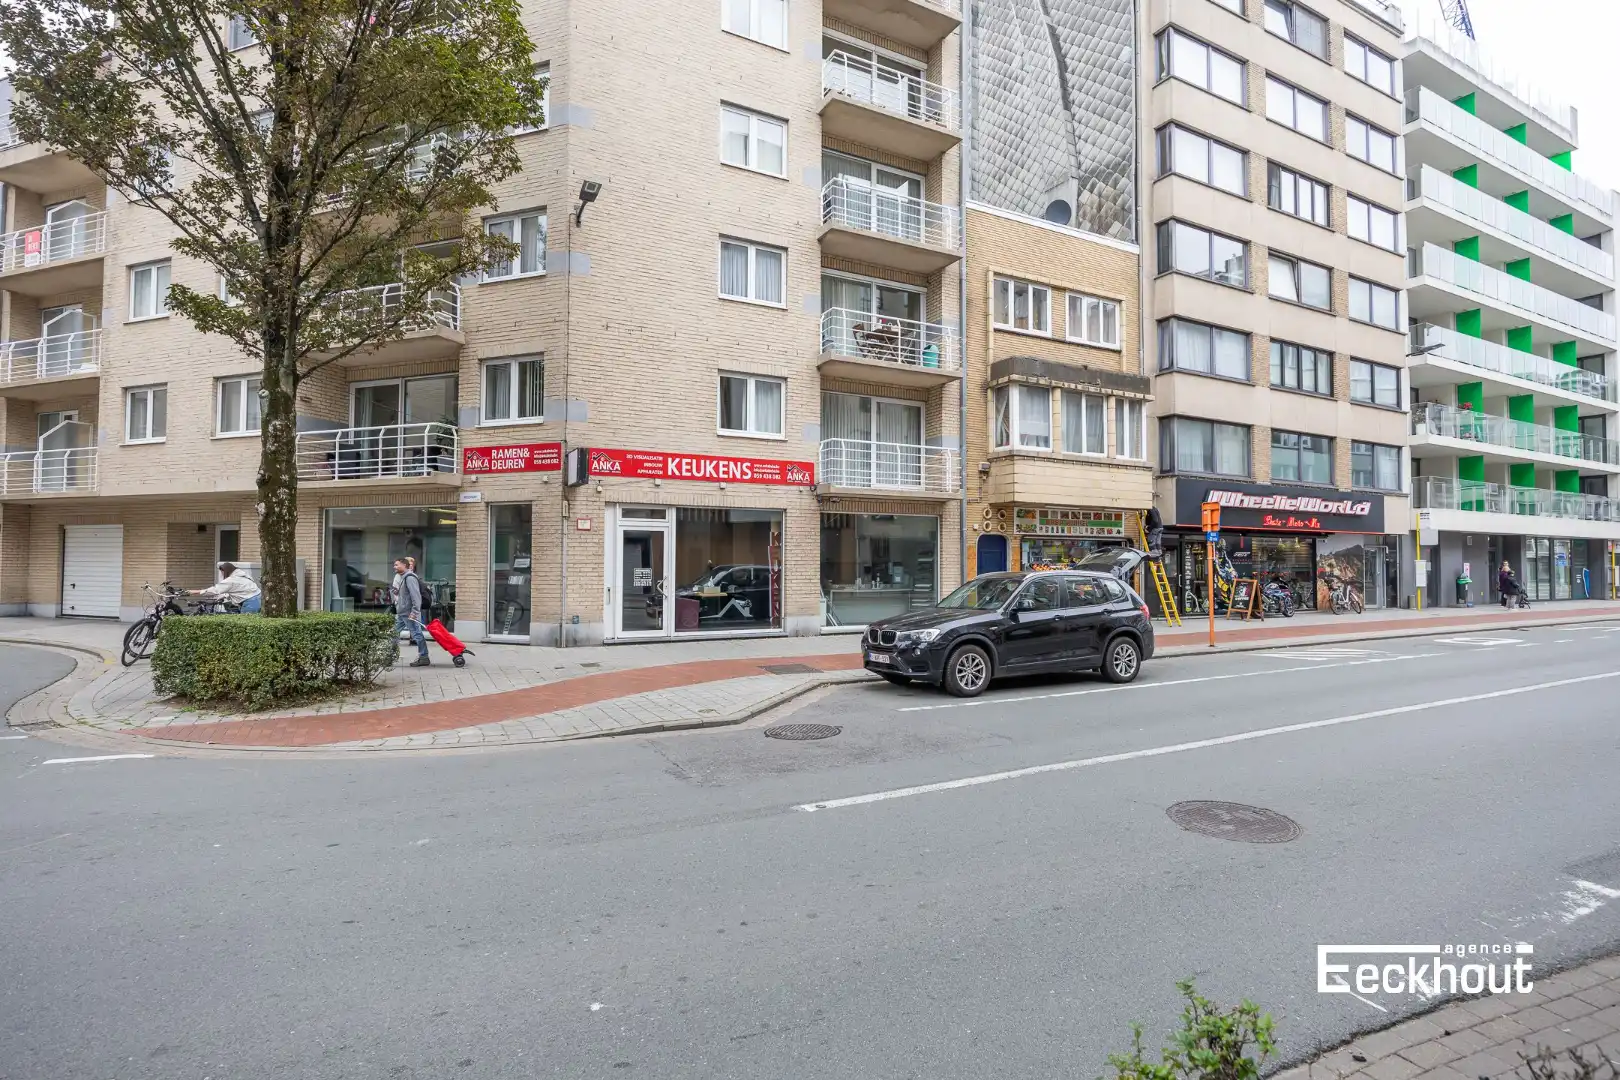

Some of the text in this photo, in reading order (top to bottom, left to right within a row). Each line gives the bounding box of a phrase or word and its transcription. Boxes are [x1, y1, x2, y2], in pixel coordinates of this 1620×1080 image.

[491, 448, 530, 460] RAMEN&
[466, 459, 489, 468] ANKA
[491, 459, 525, 470] DEUREN
[592, 461, 620, 470] ANKA
[668, 457, 752, 479] KEUKENS
[787, 473, 810, 481] ANKA
